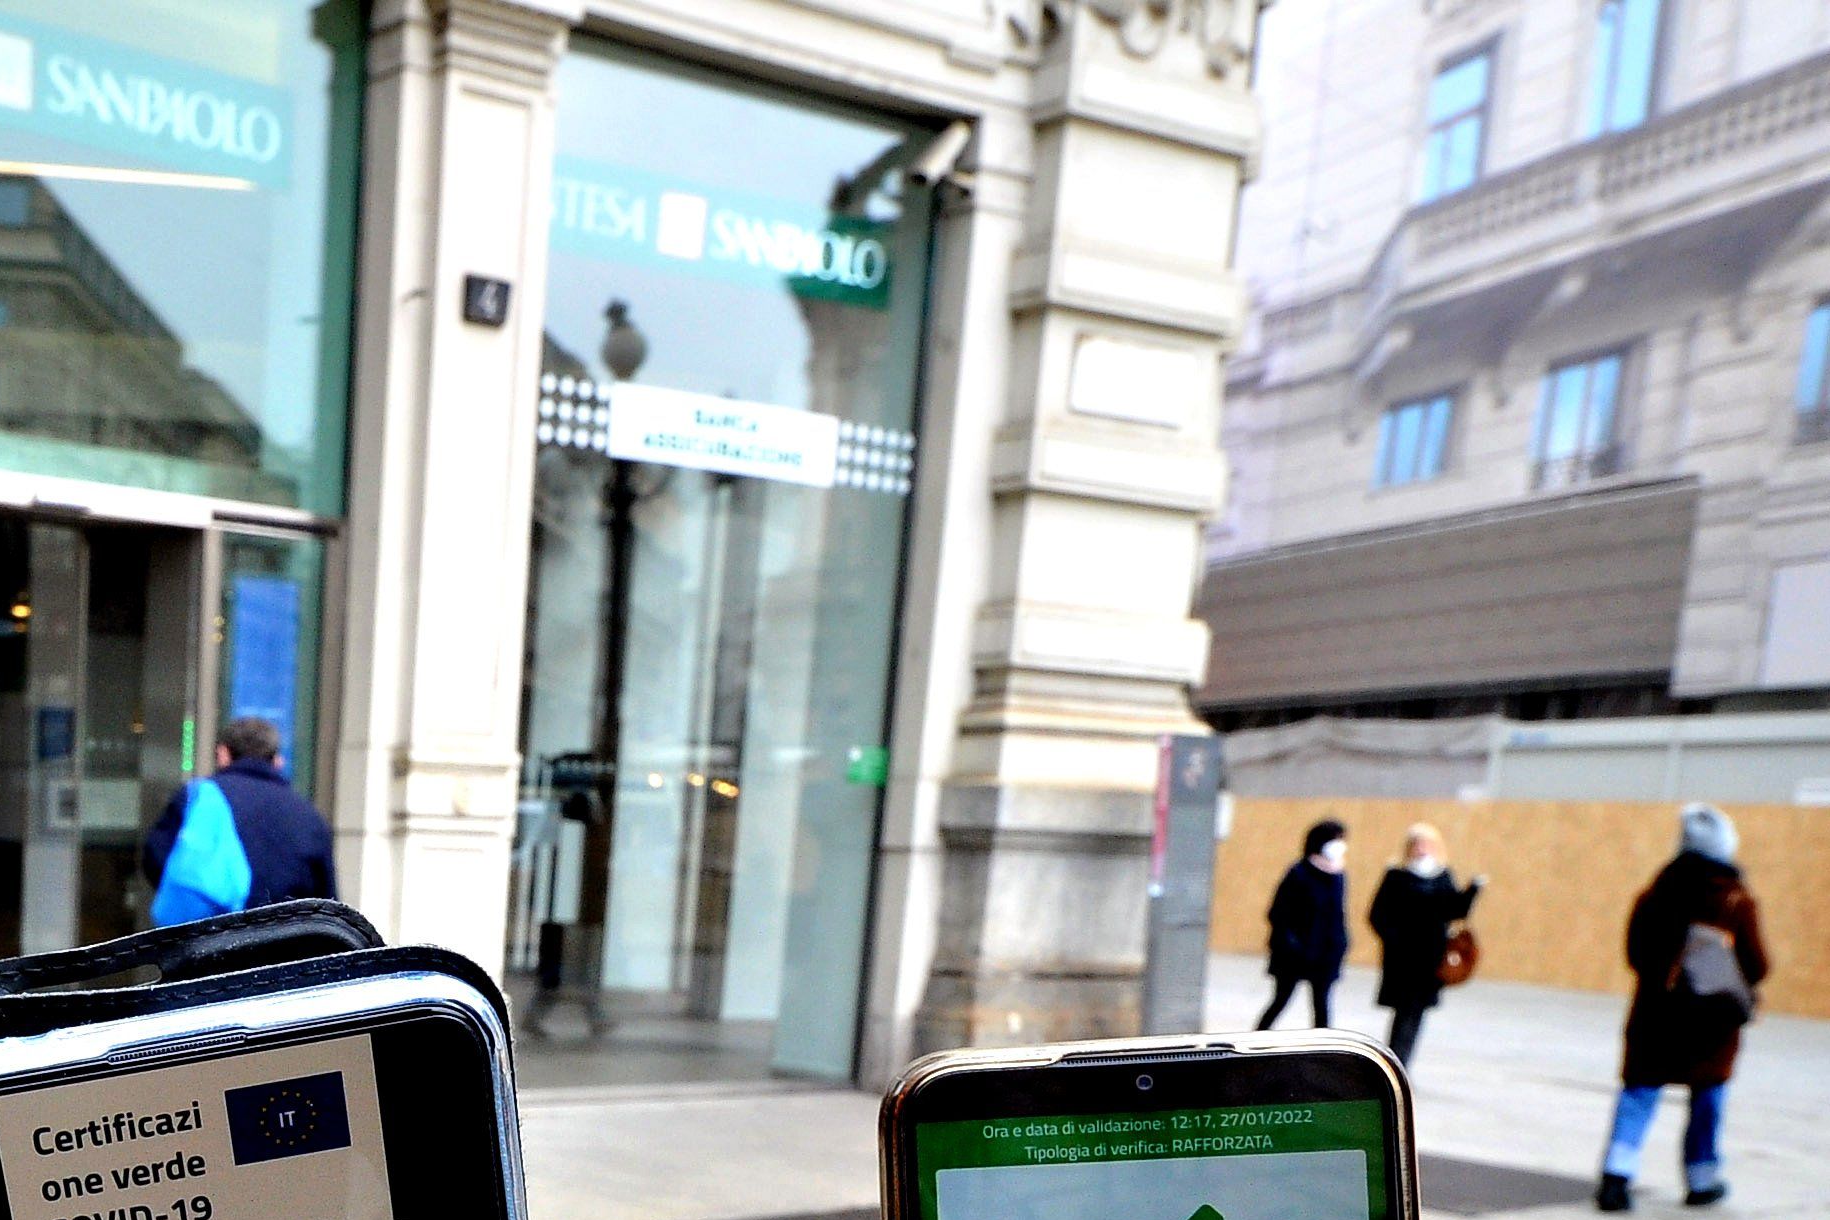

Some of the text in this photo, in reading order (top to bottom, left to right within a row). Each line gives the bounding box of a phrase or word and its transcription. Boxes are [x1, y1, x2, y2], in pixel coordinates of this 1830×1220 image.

[46, 53, 281, 163] SANPAOLO
[32, 1101, 203, 1156] Certificazi
[279, 1111, 296, 1128] IT
[983, 1109, 1313, 1139] Ora e data di validazione: 12:17, 27/01/2022
[1024, 1134, 1274, 1163] Tipologia di verifica: RAFFORZATA
[42, 1151, 206, 1202] one verde
